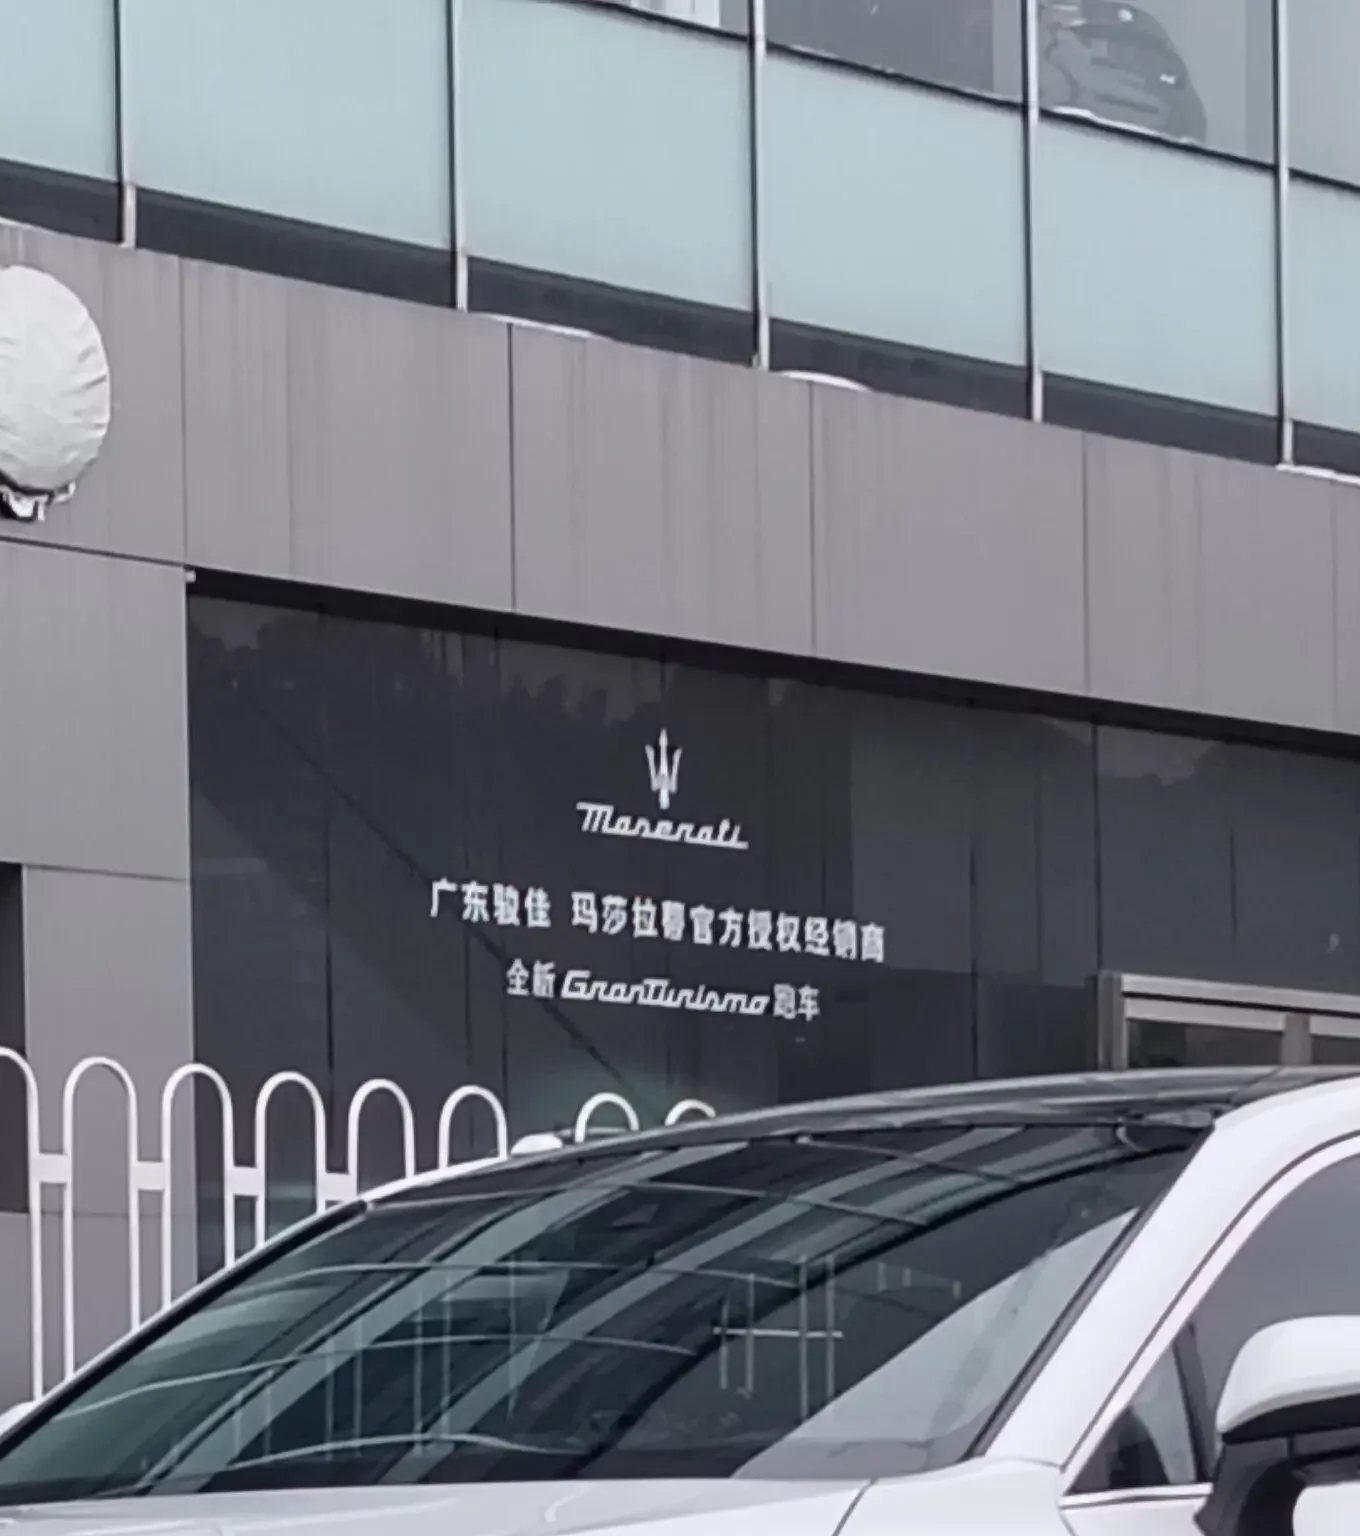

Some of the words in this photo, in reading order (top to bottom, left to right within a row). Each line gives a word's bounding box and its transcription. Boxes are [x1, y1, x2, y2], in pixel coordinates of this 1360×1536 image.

[576, 801, 750, 850] Maserati
[430, 877, 551, 929] 广东骏佳
[570, 891, 886, 963] 玛莎拉蒂官方授权经销商
[506, 958, 556, 998] 全新
[561, 969, 771, 1016] GranTurismo
[773, 983, 821, 1021] 跑车
